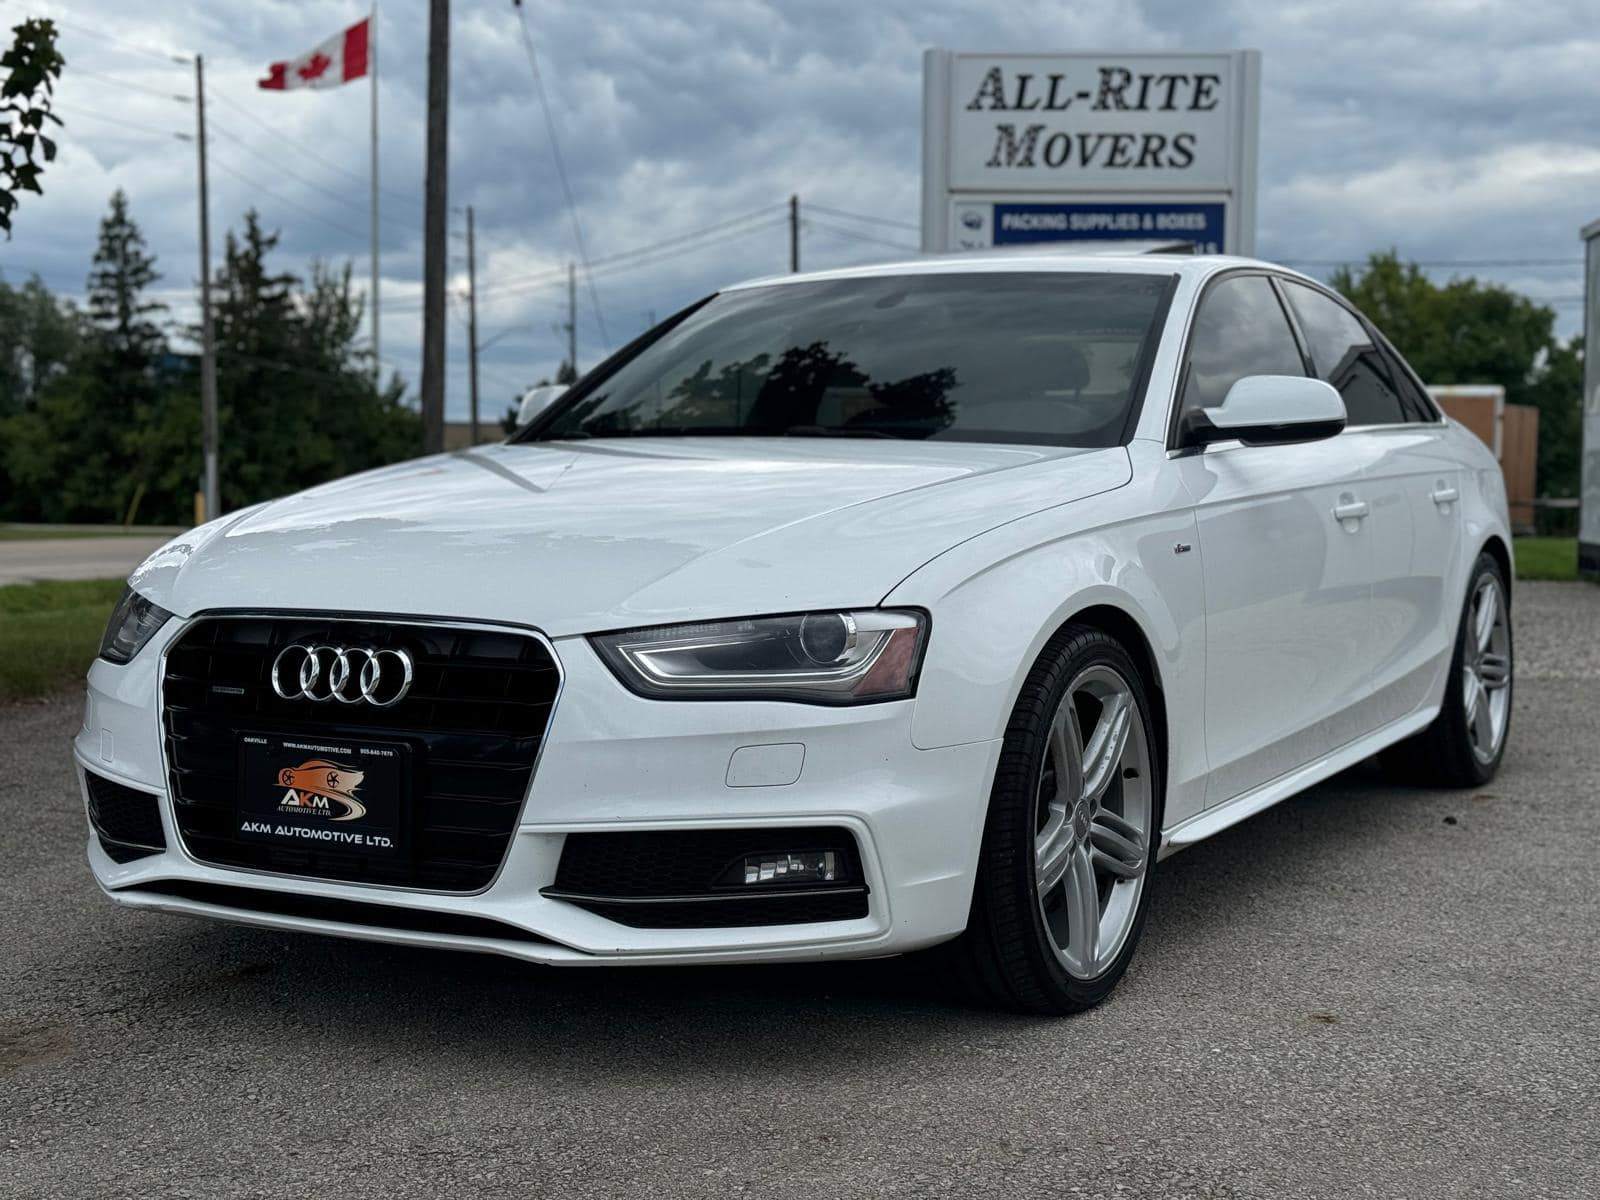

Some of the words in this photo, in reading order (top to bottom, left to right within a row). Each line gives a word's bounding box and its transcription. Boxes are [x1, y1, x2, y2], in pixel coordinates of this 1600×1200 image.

[966, 65, 1221, 112] ALL-RITE
[985, 123, 1198, 169] MOVERS
[1001, 213, 1067, 231] PACKING
[1069, 213, 1140, 231] SUPPLIES
[1142, 213, 1154, 231] &
[1156, 213, 1207, 231] BOXES
[281, 789, 329, 808] AKM
[276, 806, 317, 815] AUTOMOTIVE
[241, 822, 272, 834] AKM
[274, 824, 364, 844] AUTOMOTIVE
[366, 835, 394, 848] LTD.
